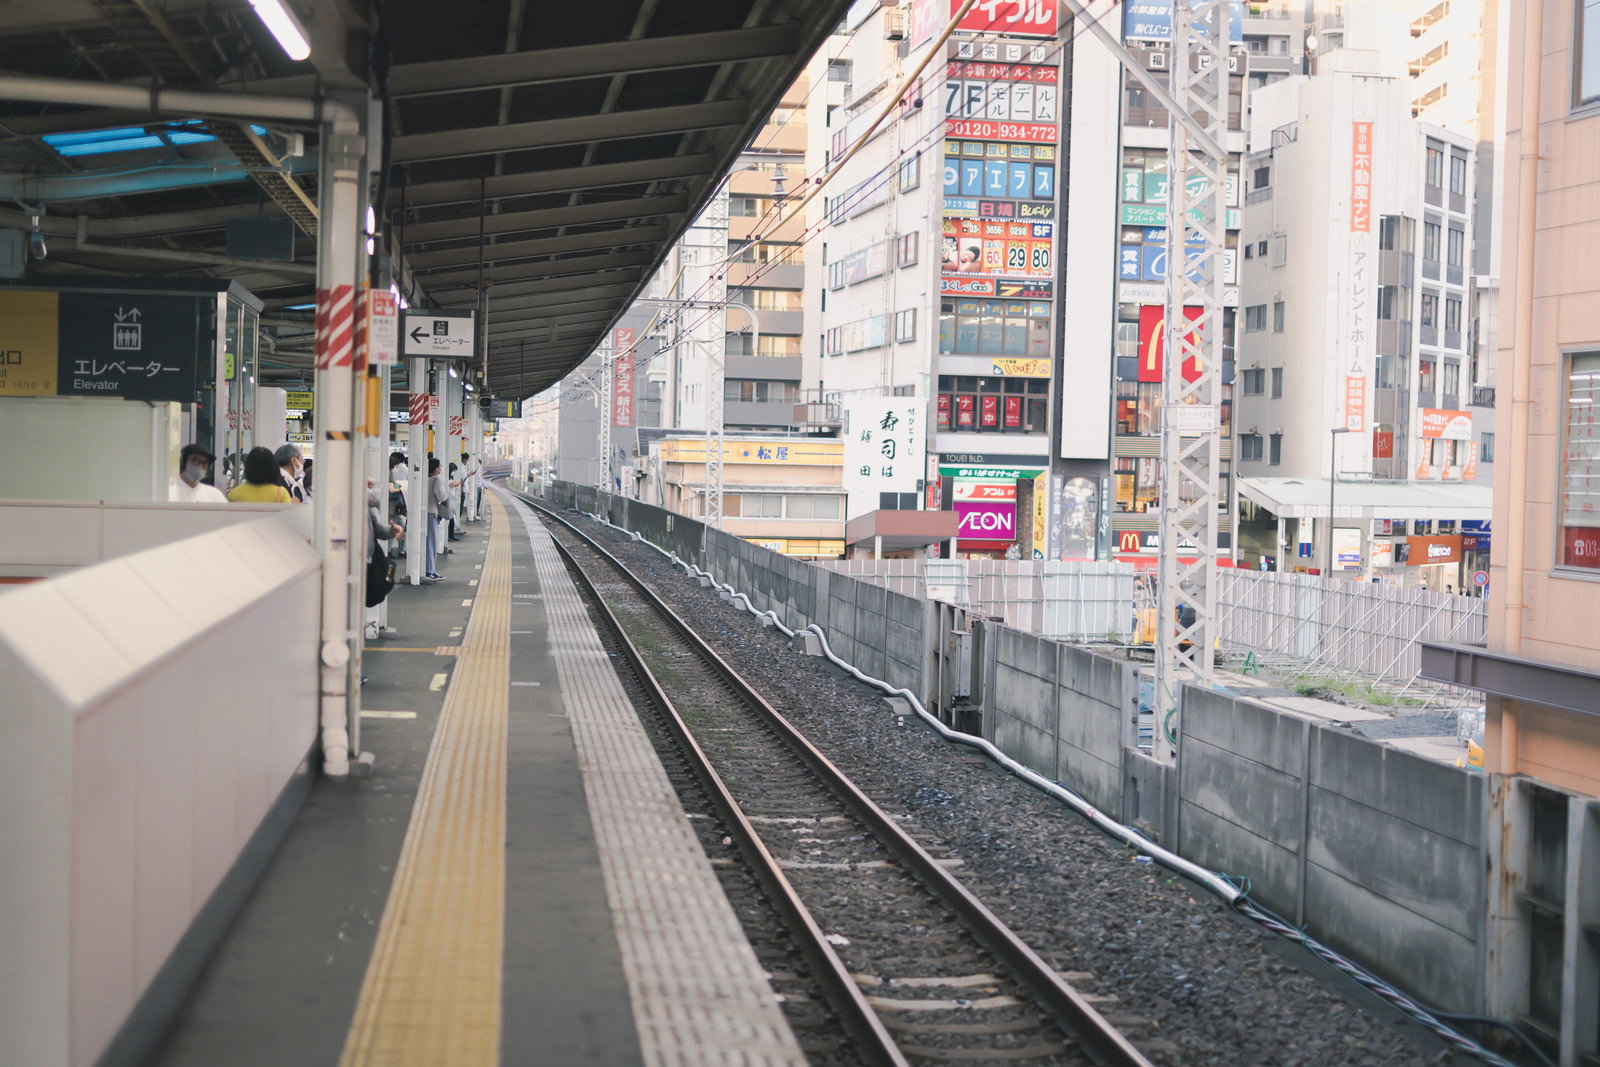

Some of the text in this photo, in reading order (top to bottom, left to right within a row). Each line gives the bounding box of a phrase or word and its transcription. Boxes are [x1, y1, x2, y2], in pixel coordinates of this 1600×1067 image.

[967, 167, 1050, 191] アエラス
[73, 359, 181, 377] エレベーター
[73, 378, 119, 390] Elevator
[757, 445, 789, 461] 松屋
